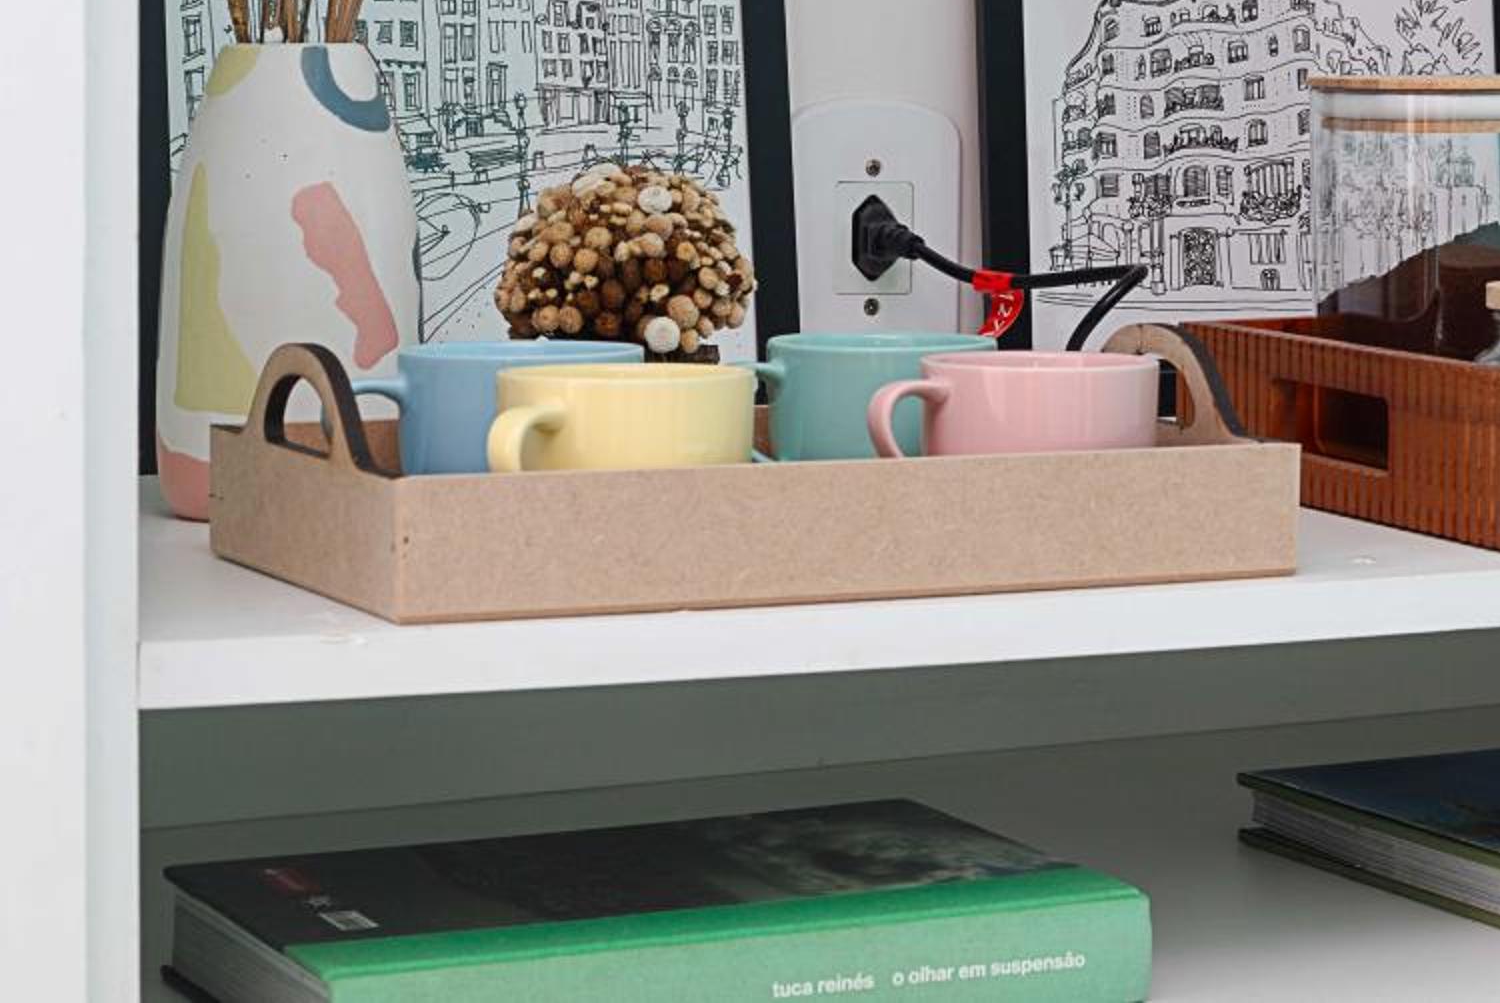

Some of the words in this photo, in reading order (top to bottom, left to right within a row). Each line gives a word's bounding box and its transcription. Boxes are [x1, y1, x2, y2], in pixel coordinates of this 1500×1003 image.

[771, 980, 813, 998] tuca
[892, 970, 905, 986] o
[908, 964, 955, 985] olhar
[958, 963, 987, 979] em
[991, 951, 1086, 977] suspensão
